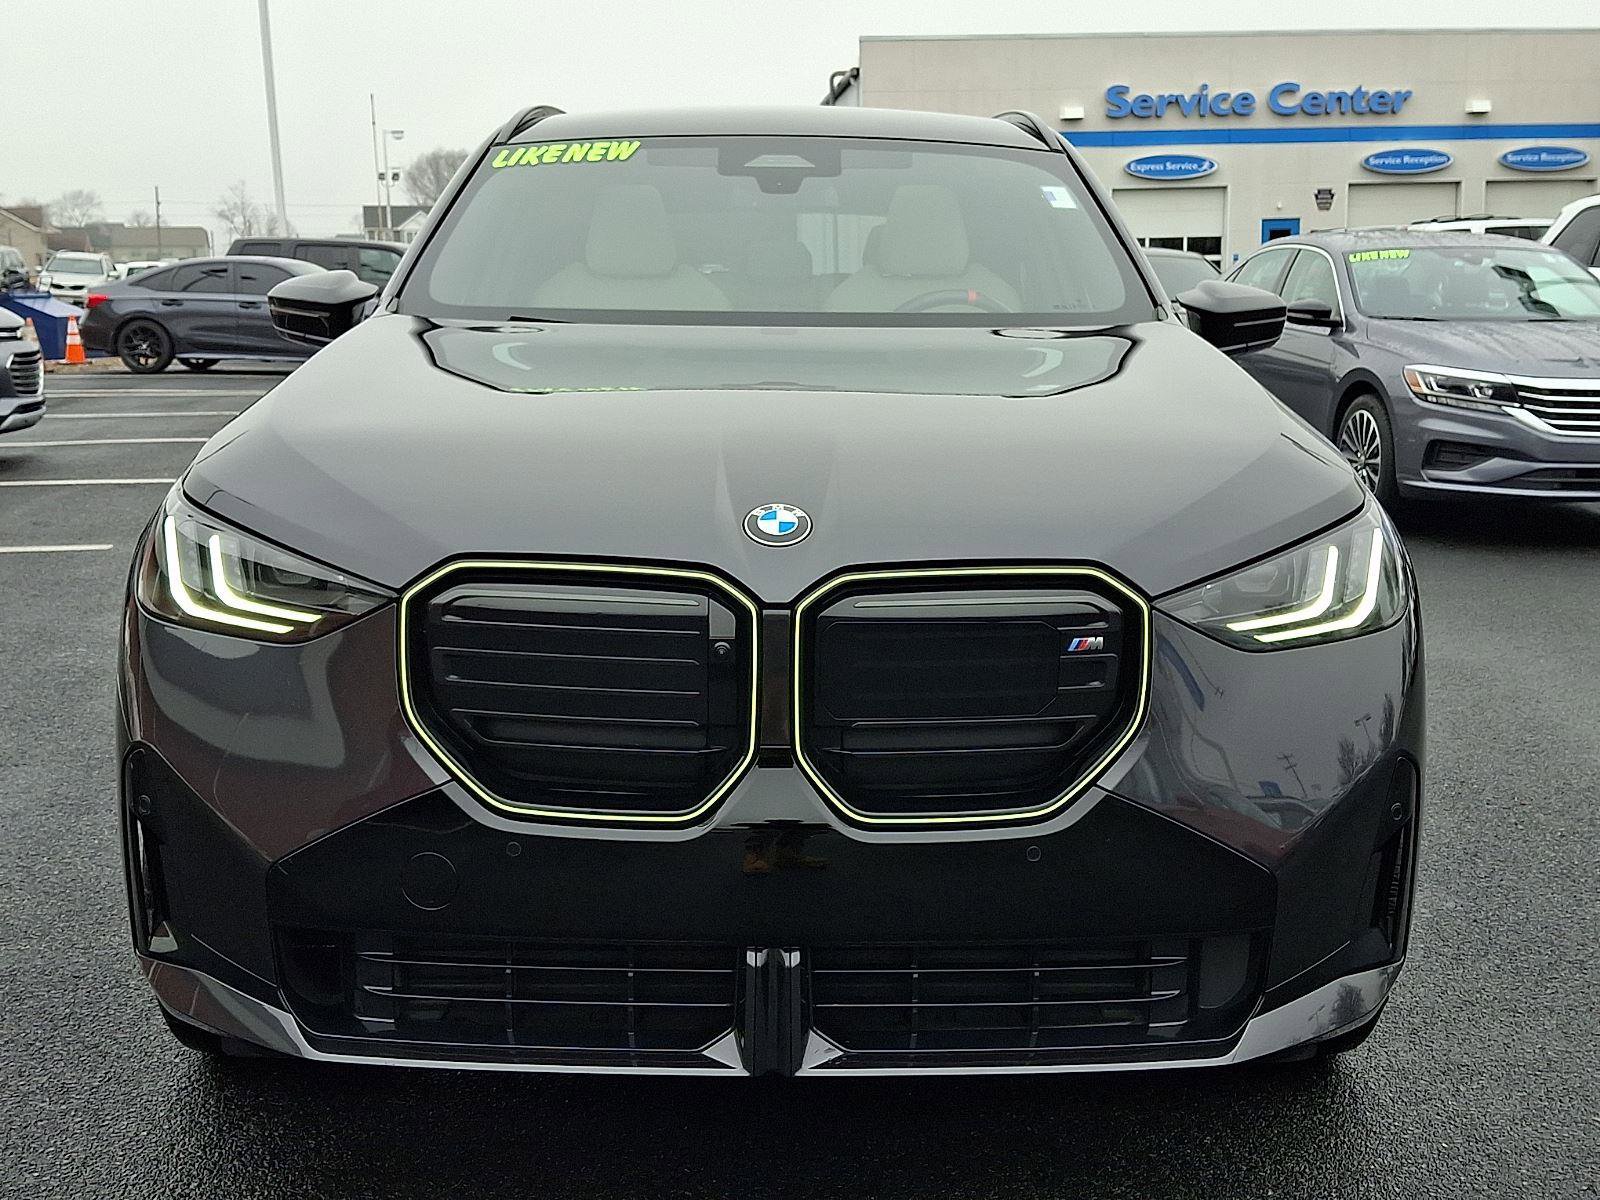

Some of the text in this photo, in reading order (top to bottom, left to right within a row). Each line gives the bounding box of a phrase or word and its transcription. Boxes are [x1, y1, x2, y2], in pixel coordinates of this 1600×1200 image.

[1105, 82, 1413, 119] Service Center
[1368, 155, 1449, 166] Service Reception
[1506, 152, 1586, 163] Service Reception
[1130, 161, 1198, 173] Express Service
[1348, 249, 1410, 263] LIKE NEW
